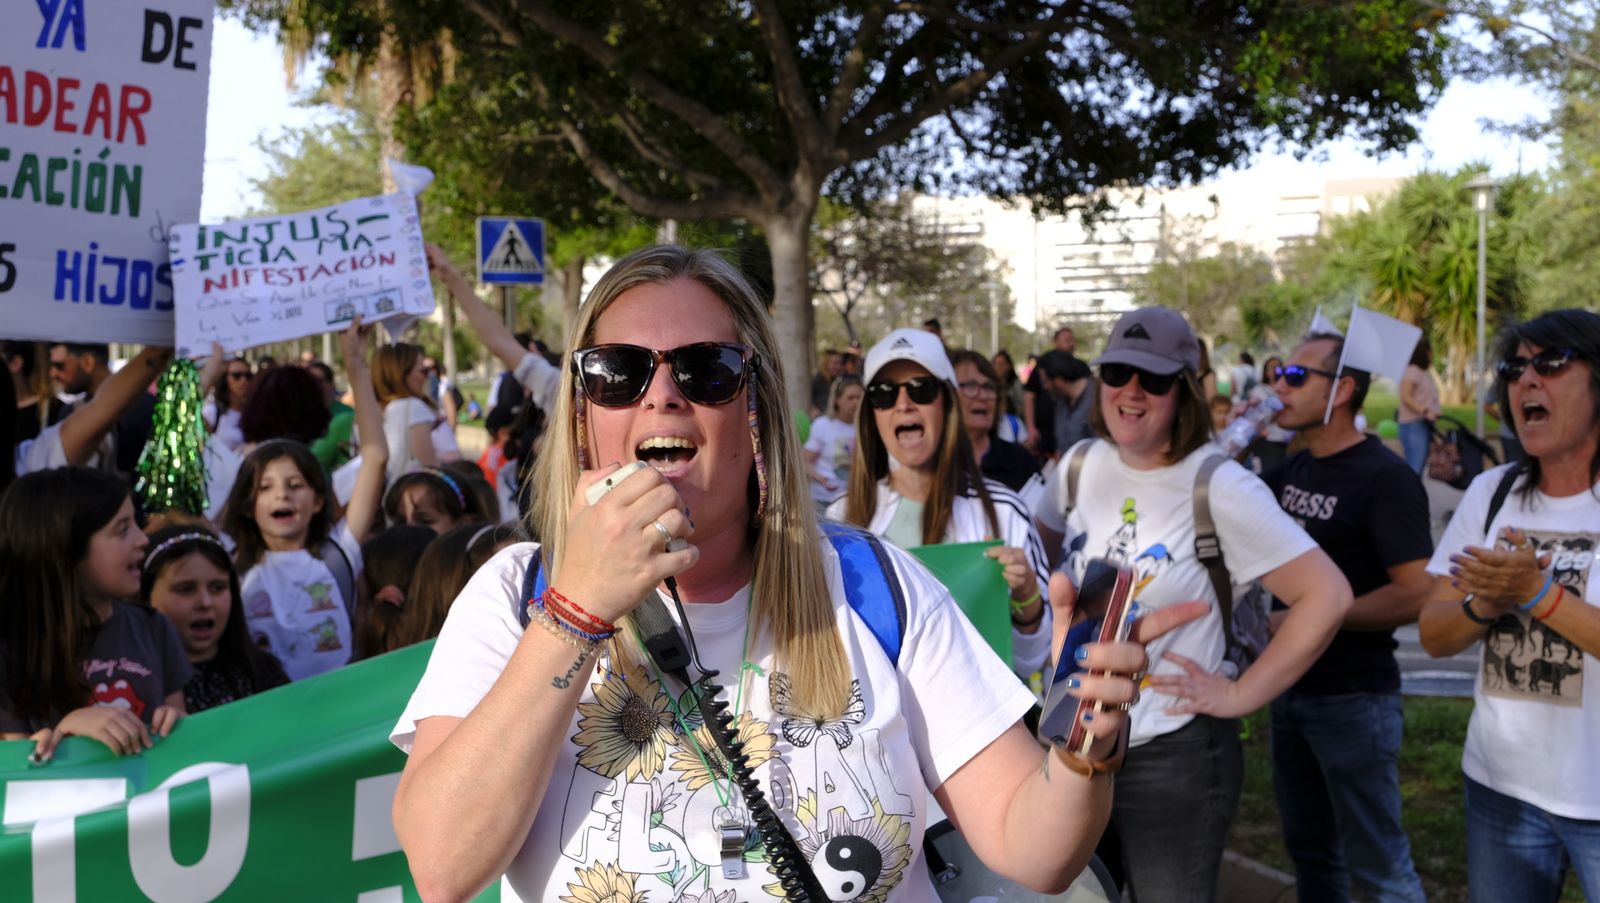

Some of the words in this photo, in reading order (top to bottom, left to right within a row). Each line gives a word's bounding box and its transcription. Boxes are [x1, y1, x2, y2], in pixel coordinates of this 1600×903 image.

[36, 0, 86, 52] YA
[141, 8, 203, 71] DE
[551, 647, 591, 689] Brun
